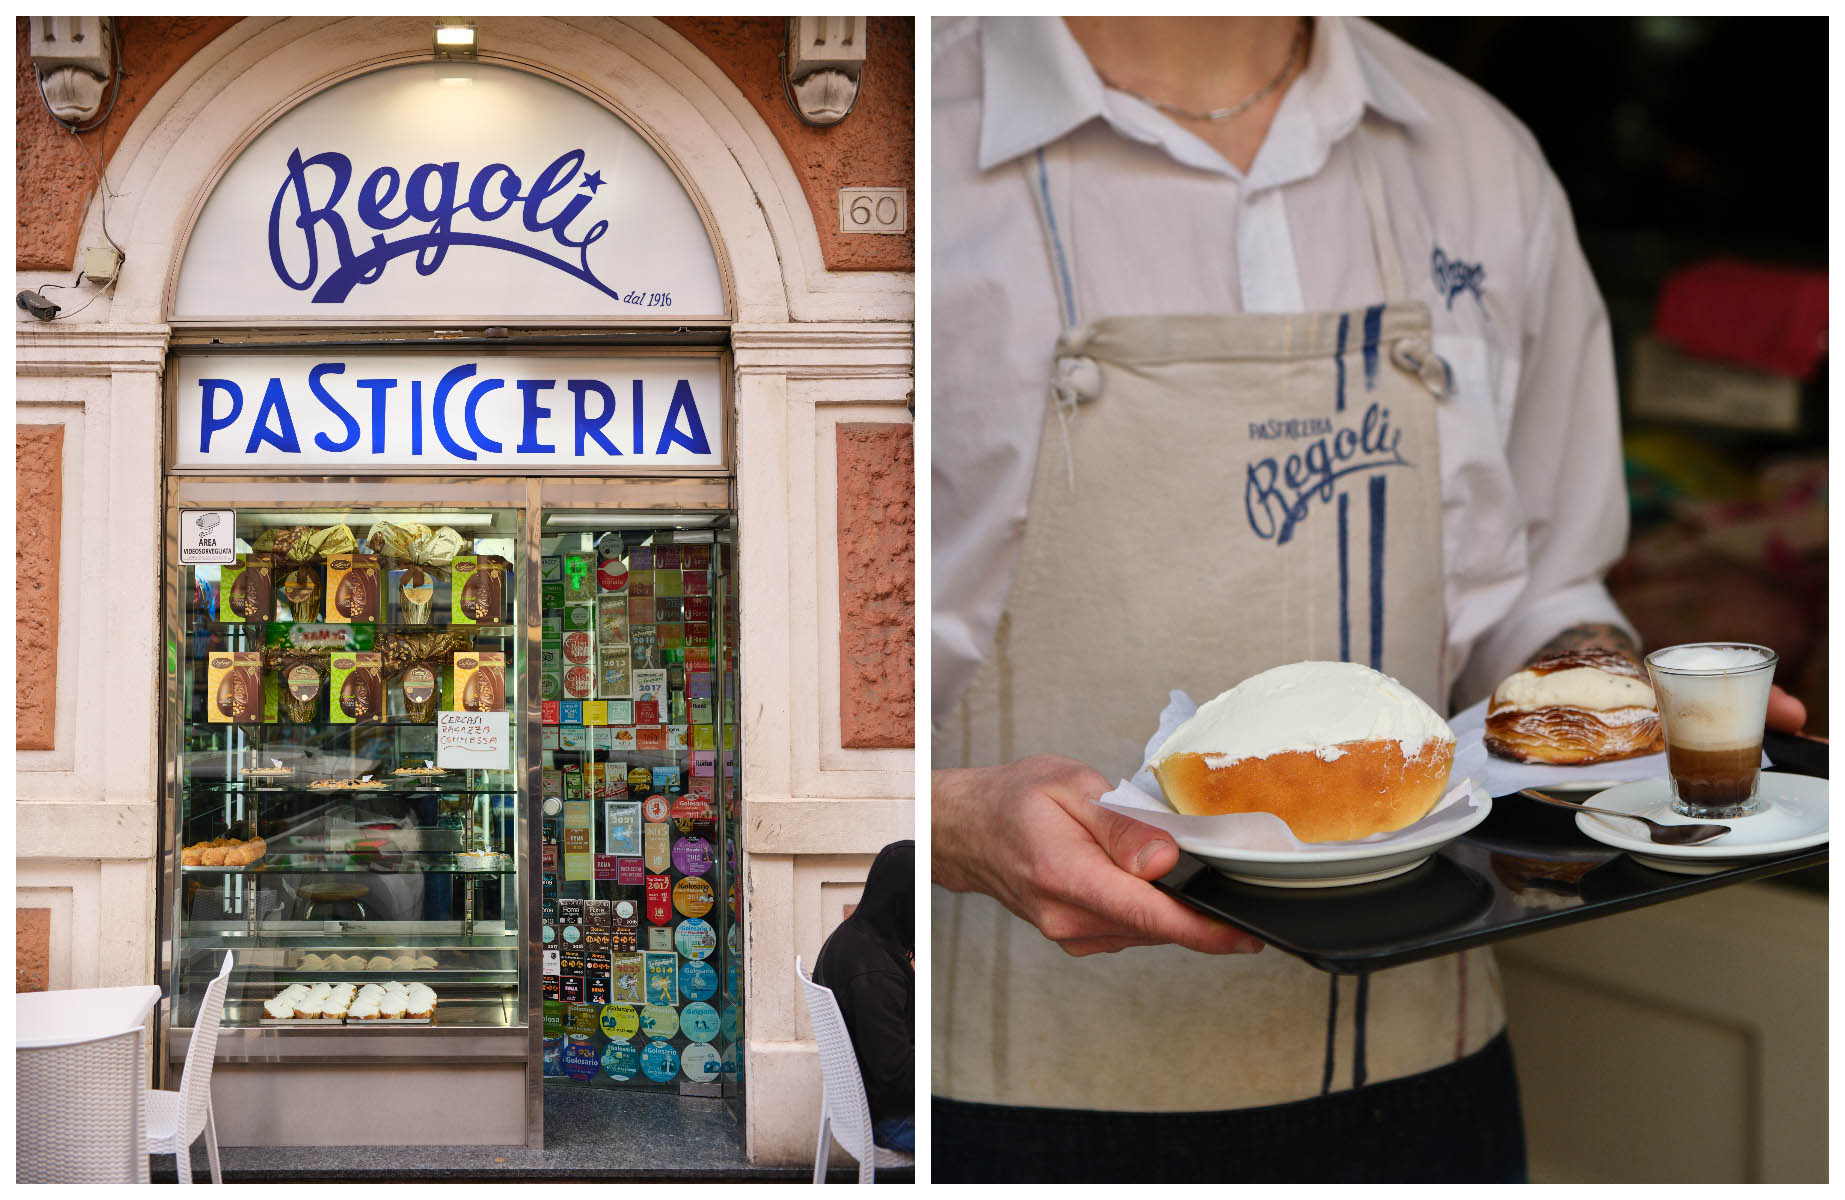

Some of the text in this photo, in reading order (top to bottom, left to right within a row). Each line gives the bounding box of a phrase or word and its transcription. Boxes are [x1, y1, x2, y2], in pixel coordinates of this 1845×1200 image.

[850, 196, 897, 225] 60
[268, 147, 619, 304] Regoli
[623, 290, 672, 307] dal 1916
[198, 362, 712, 462] PASTICCERIA
[1246, 403, 1414, 546] Regoli
[198, 538, 217, 547] AREA
[648, 882, 669, 890] 2017
[565, 1056, 598, 1066] Golosario
